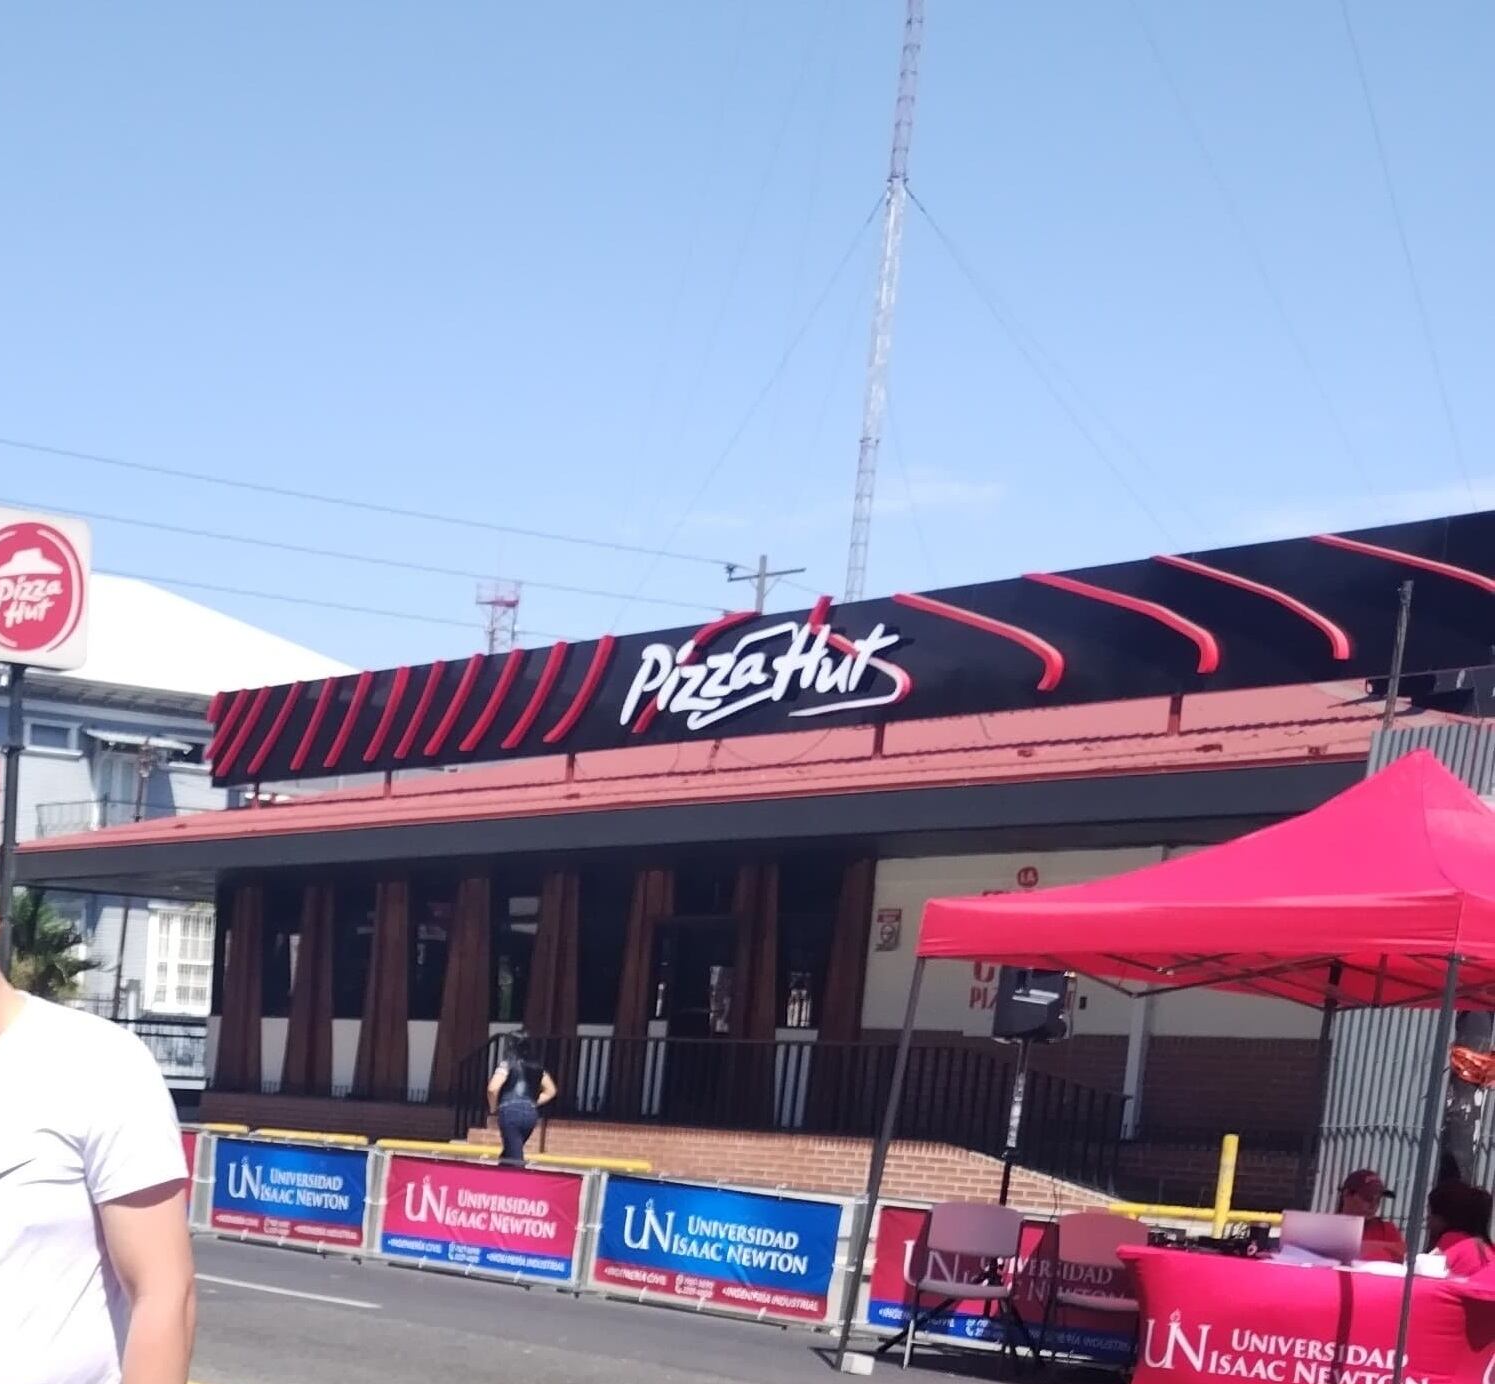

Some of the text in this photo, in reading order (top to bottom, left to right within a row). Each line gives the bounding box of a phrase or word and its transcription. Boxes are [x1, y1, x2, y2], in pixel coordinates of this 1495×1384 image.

[3, 599, 56, 629] Hut
[619, 621, 900, 727] Pizza Hut
[227, 1161, 264, 1200] UN
[260, 1184, 350, 1211] ISAAC NEWTON
[269, 1167, 344, 1191] UNIVERSIDAD
[404, 1181, 449, 1225] UN
[457, 1189, 550, 1218] UNIVERSIDAD
[444, 1206, 557, 1240] ISAAC NEWTON
[623, 1204, 676, 1254] UN
[687, 1214, 800, 1251] UNIVERSIDAD
[671, 1232, 809, 1277] ISAAC NEWTON
[1144, 1317, 1212, 1374] UN
[1230, 1328, 1409, 1369] UNIVERSIDAD
[1207, 1350, 1287, 1383] ISAAC
